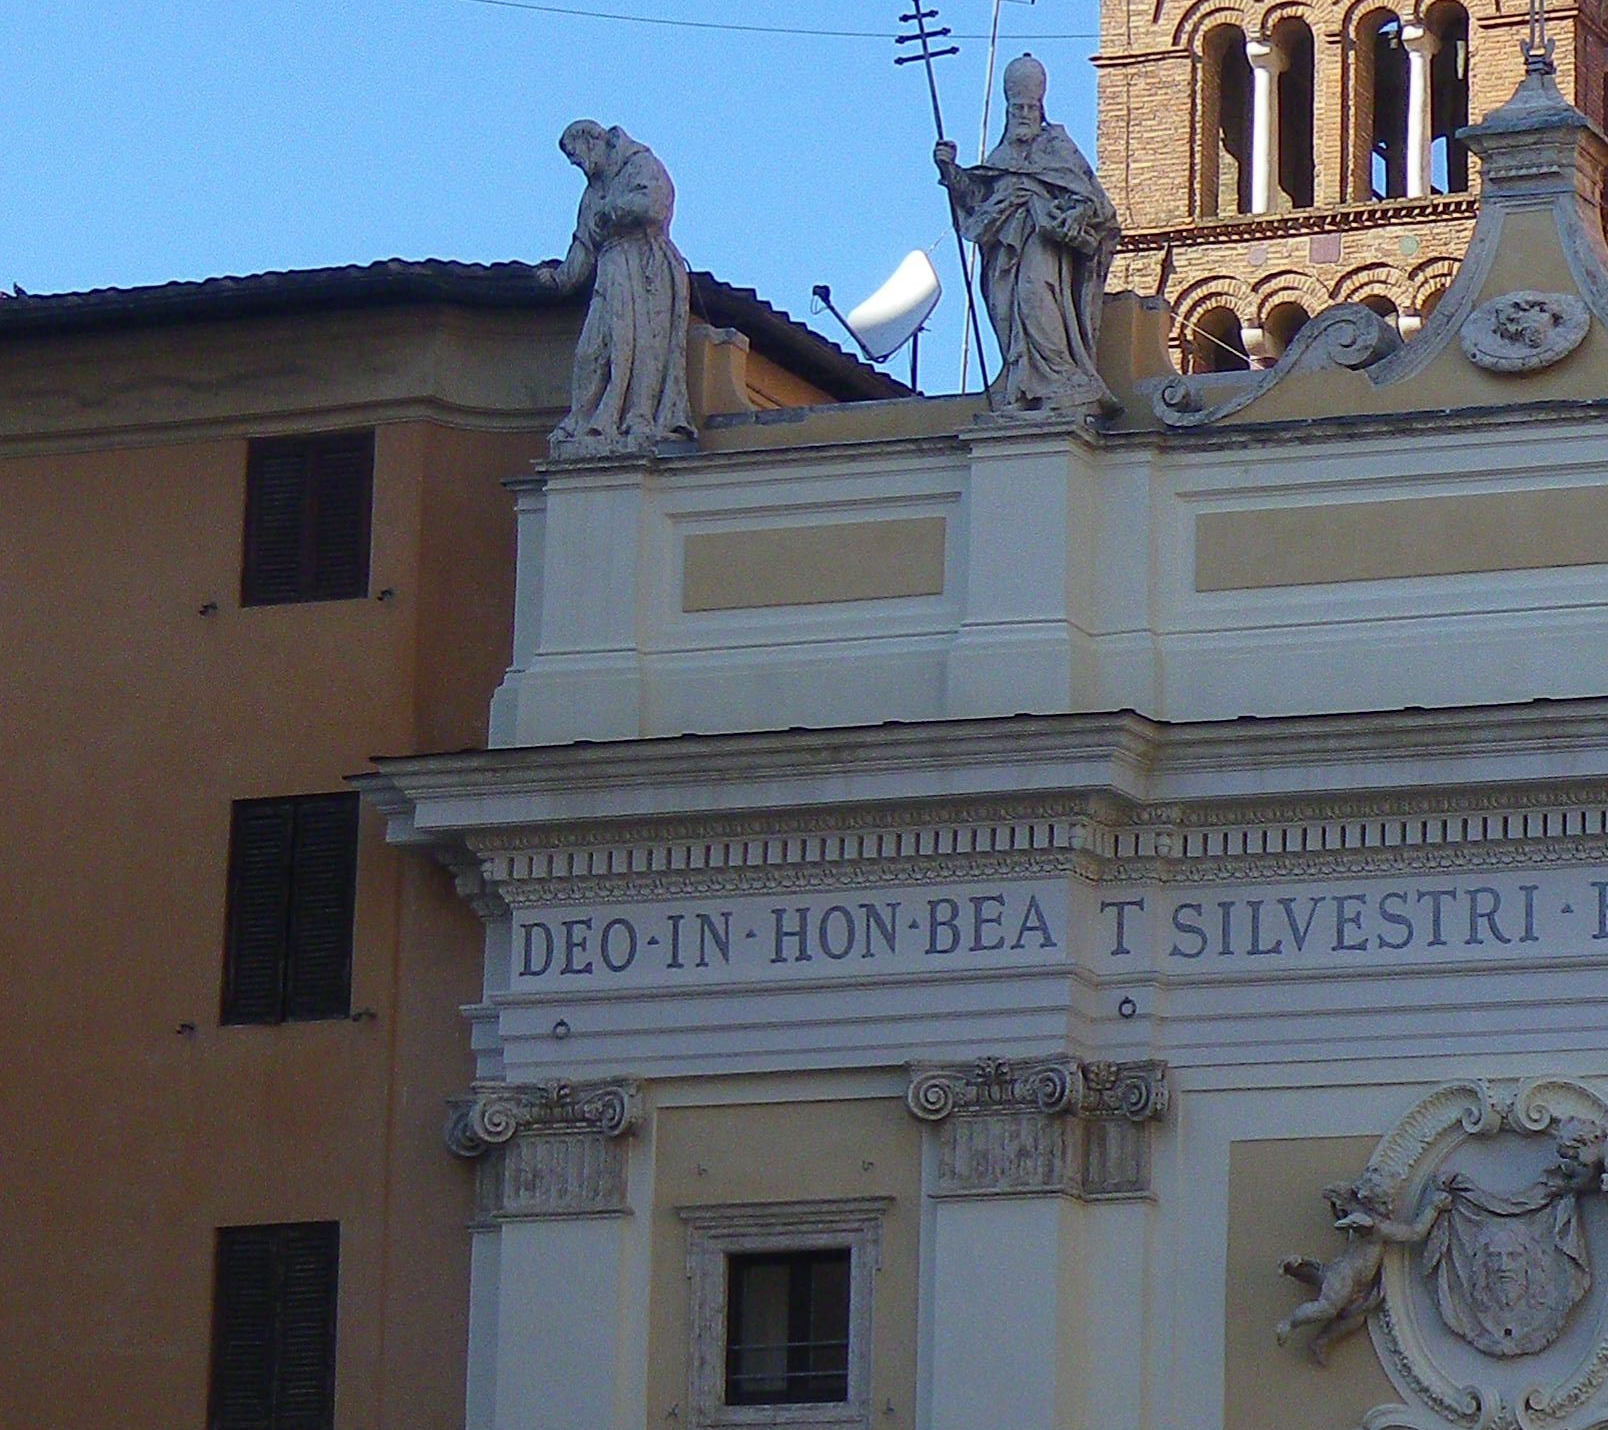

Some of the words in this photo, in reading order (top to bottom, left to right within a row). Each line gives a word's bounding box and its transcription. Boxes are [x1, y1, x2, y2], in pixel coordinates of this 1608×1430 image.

[517, 917, 638, 978] DEO
[665, 911, 733, 970] IN
[769, 901, 902, 965] HON
[1168, 884, 1540, 960] SILVESTRI
